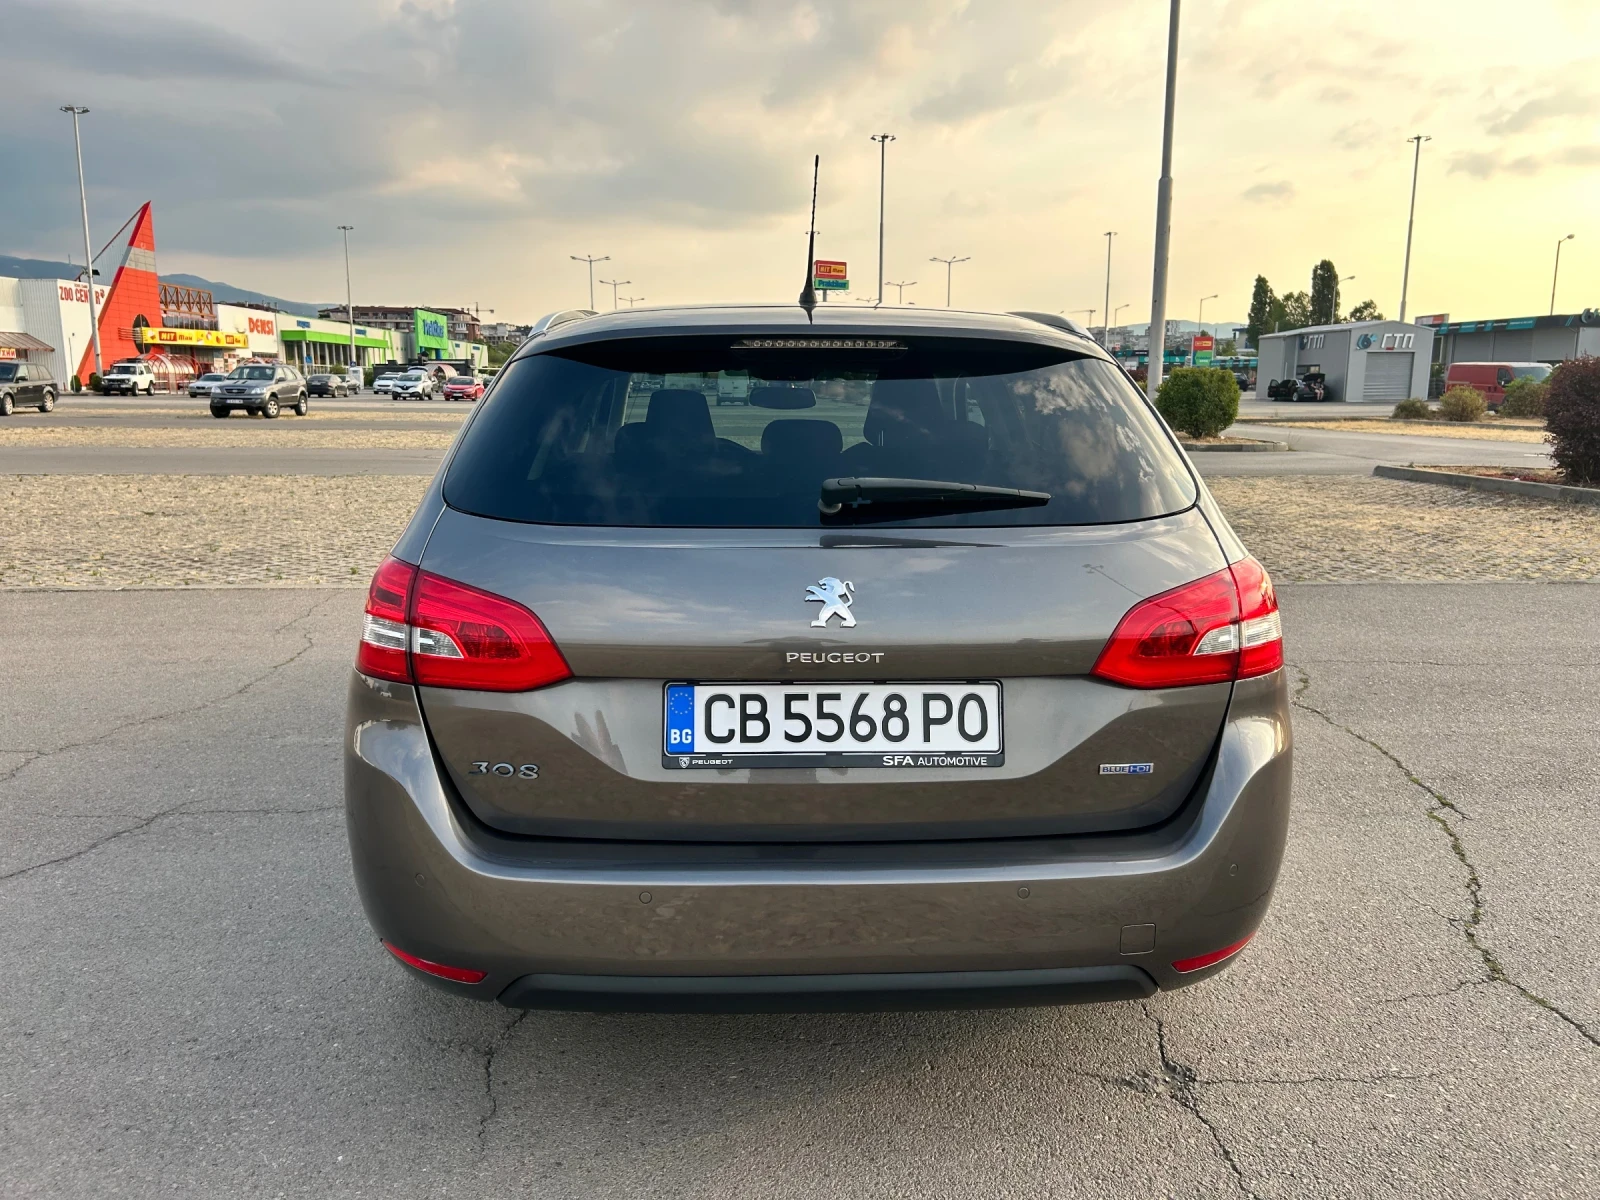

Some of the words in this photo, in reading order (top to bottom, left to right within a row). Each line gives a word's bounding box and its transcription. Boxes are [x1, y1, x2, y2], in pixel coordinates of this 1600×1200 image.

[59, 286, 73, 301] ZOO
[75, 288, 101, 304] CENR
[160, 332, 175, 341] HIT
[1381, 333, 1415, 349] ГТП
[786, 652, 885, 663] PEUGEOT
[704, 693, 771, 744] CB
[784, 693, 910, 743] 5568
[670, 728, 692, 744] BG
[882, 755, 915, 766] SFA
[917, 757, 988, 766] AUTOMOTIVE
[468, 761, 540, 780] 308
